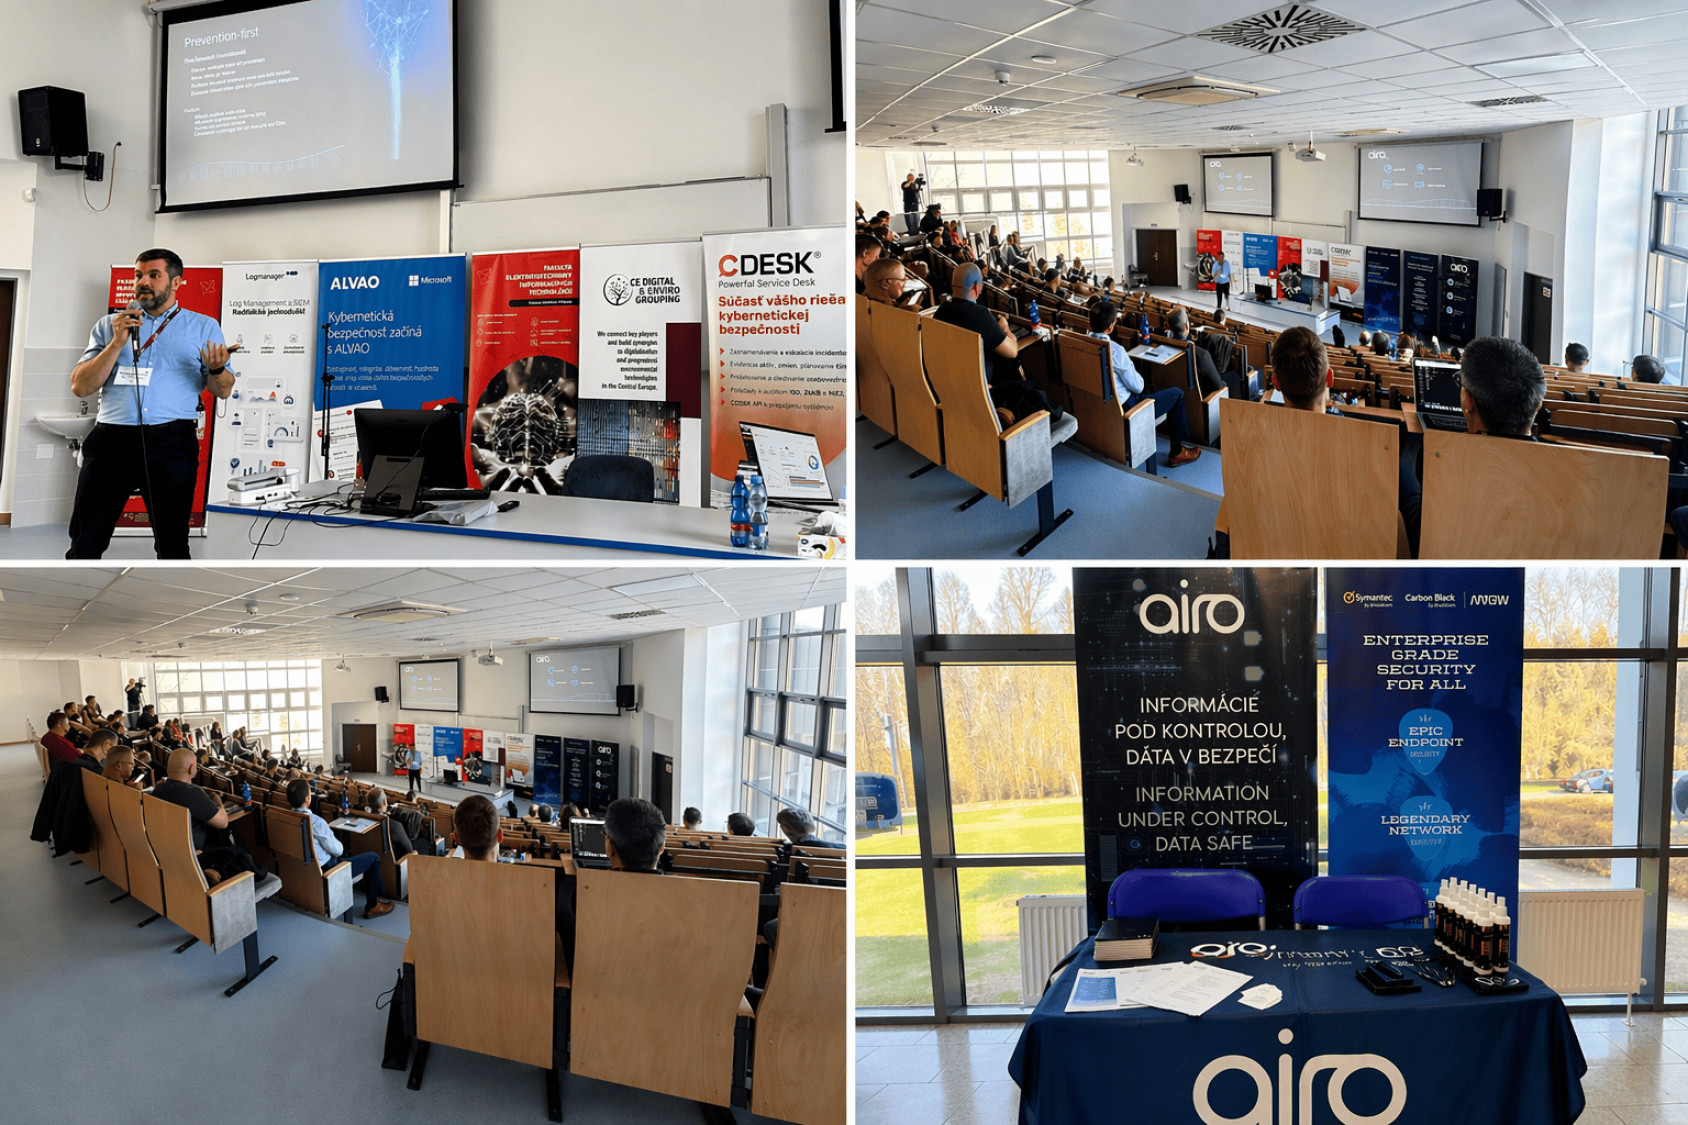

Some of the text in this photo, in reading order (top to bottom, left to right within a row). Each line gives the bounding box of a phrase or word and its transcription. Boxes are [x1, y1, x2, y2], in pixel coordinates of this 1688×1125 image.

[184, 26, 260, 48] Prevention-first
[330, 275, 380, 290] ALVAO
[420, 275, 453, 284] Microsoft
[630, 277, 675, 287] CE DIGITAL
[756, 279, 790, 288] Service
[792, 277, 816, 287] Desk
[647, 286, 680, 295] ENVIRO
[635, 295, 680, 304] GROUPING
[328, 310, 394, 325] Kybernetická
[719, 309, 809, 323] kybernetickej
[719, 323, 801, 337] bezpečnosti
[334, 342, 371, 354] ALVAO
[1355, 593, 1393, 603] Symantec
[1405, 594, 1433, 602] Carbon
[1139, 578, 1246, 635] airo
[1362, 634, 1489, 646] ENTERPRISE
[1391, 649, 1459, 660] GRADE
[1376, 664, 1477, 675] SECURITY
[1386, 679, 1467, 690] FOR ALL
[1140, 692, 1259, 713] INFORMÁCIE
[1114, 722, 1287, 741] POD KONTROLOU,
[1408, 726, 1444, 736] EPIC
[1388, 738, 1464, 747] ENDPOINT
[1179, 749, 1192, 765] V
[1198, 743, 1278, 765] BEZPEČÍ
[1135, 785, 1270, 802] INFORMATION
[1118, 809, 1288, 828] UNDER CONTROL,
[1381, 814, 1471, 825] LEGENDARY
[1388, 825, 1463, 836] NETWORK
[1155, 835, 1254, 851] DATA SAFE
[1192, 1028, 1408, 1125] airo
